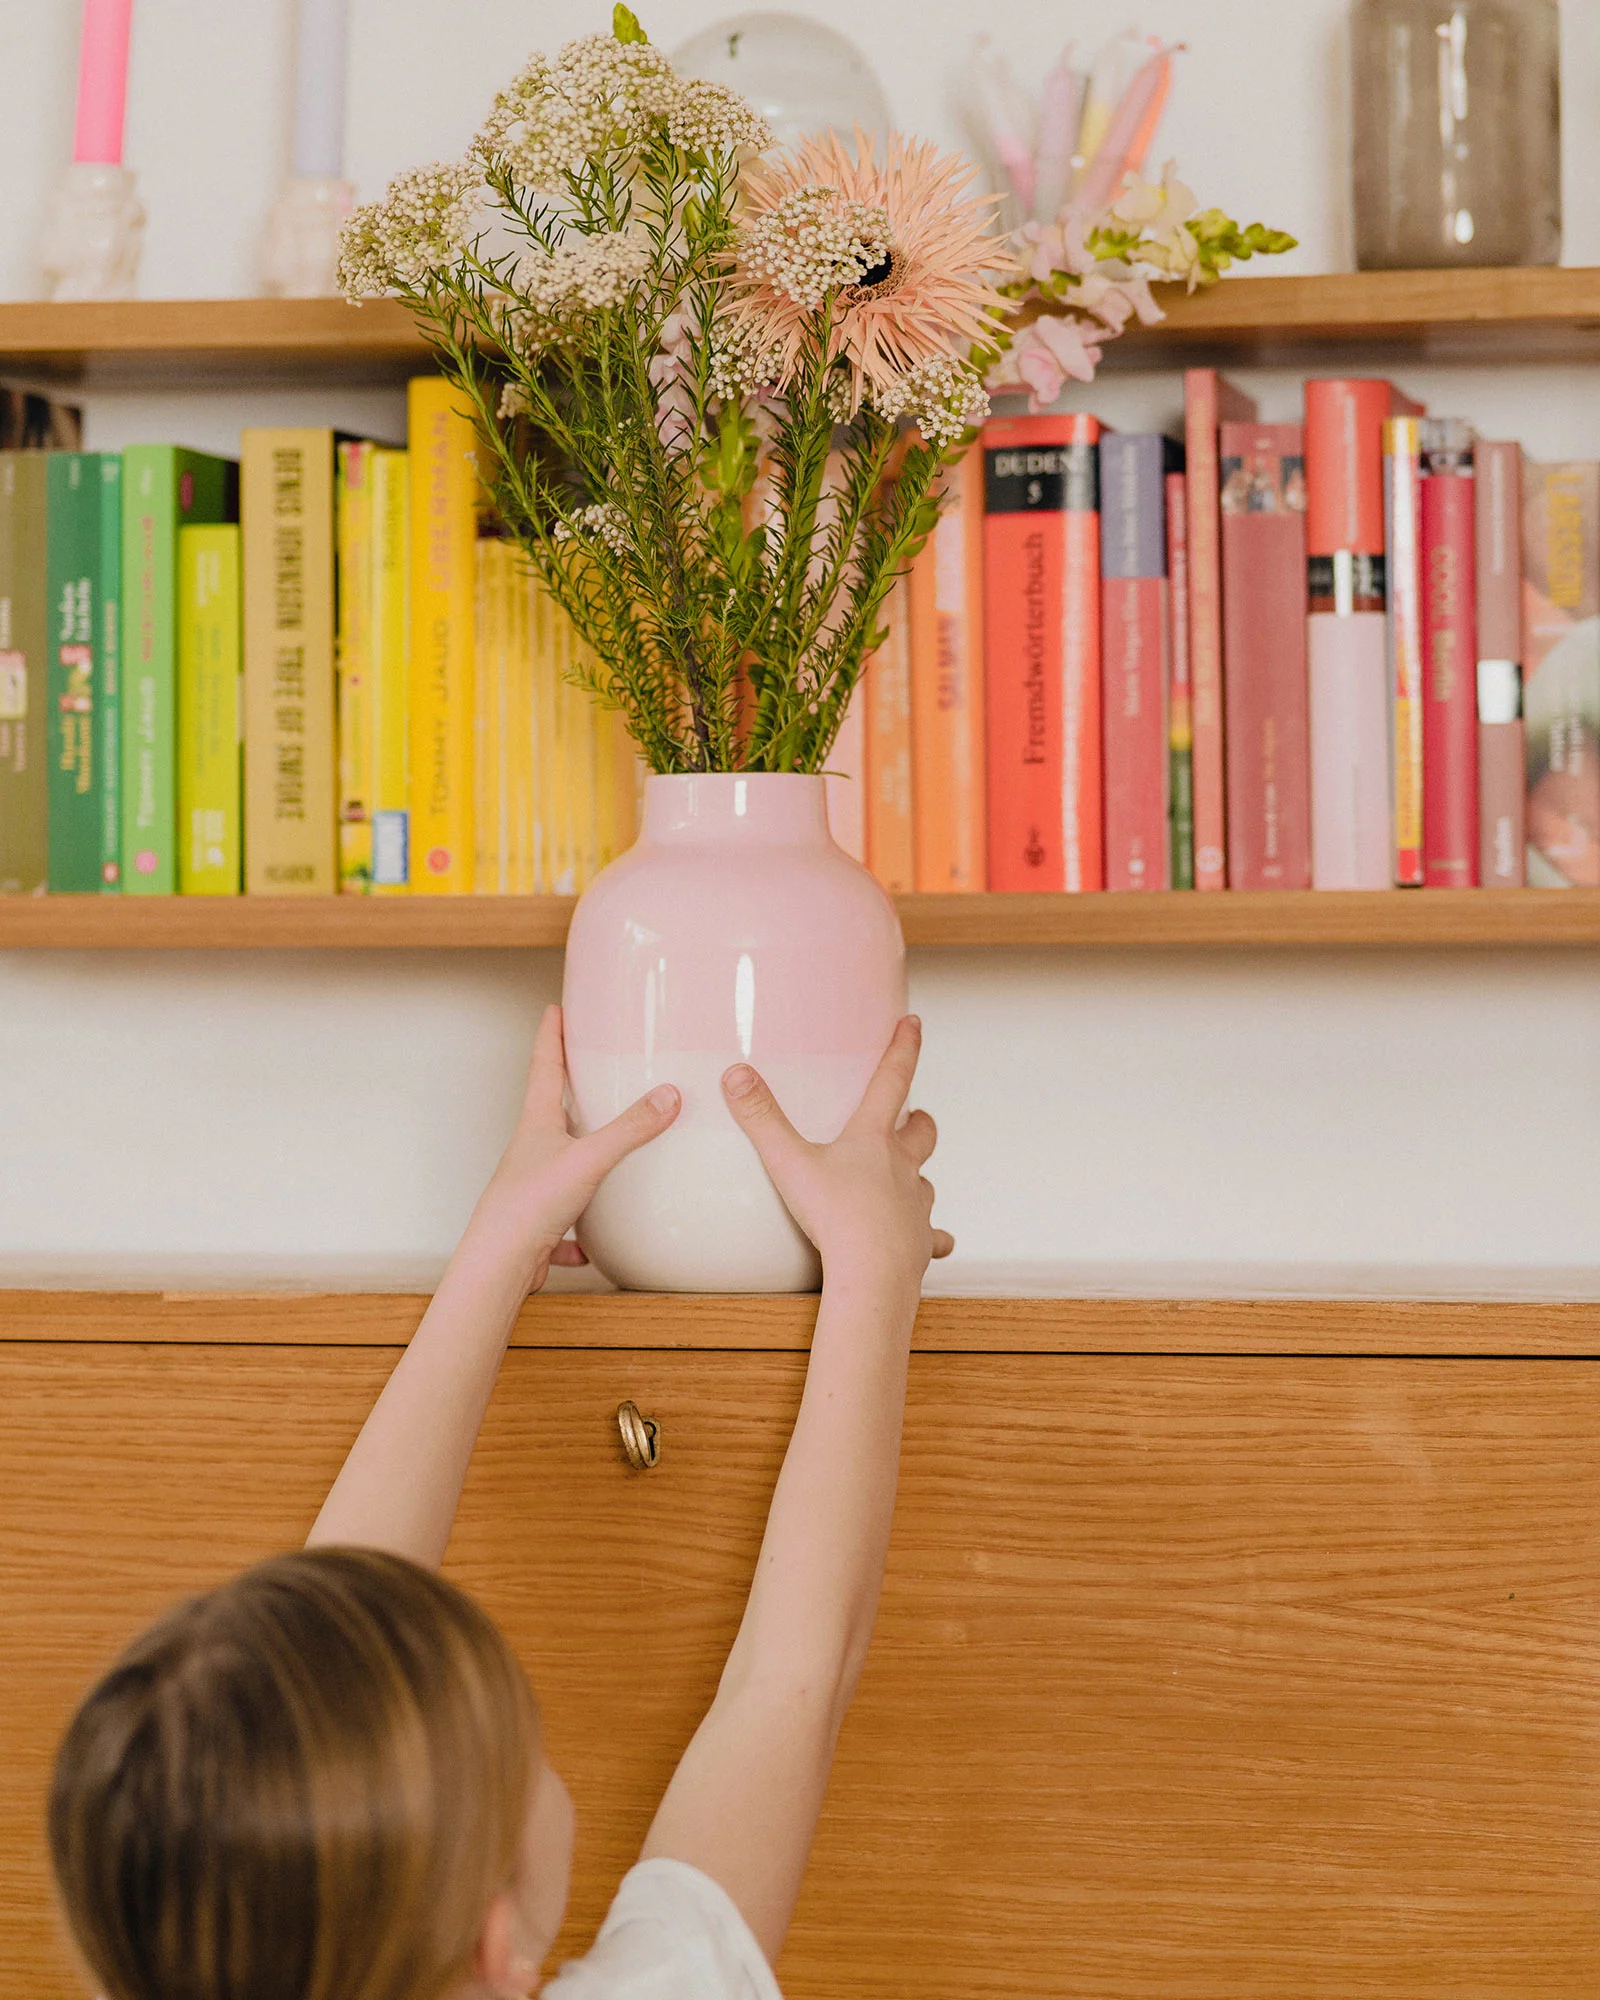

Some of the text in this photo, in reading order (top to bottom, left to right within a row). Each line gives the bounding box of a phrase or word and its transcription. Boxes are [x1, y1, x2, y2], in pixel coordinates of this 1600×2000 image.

[275, 448, 303, 516] DENIS
[994, 452, 1082, 478] DUDEN
[275, 526, 304, 629] JOHNSON
[1022, 530, 1045, 766] Fremdwörterbuch
[430, 717, 449, 815] TOMMY
